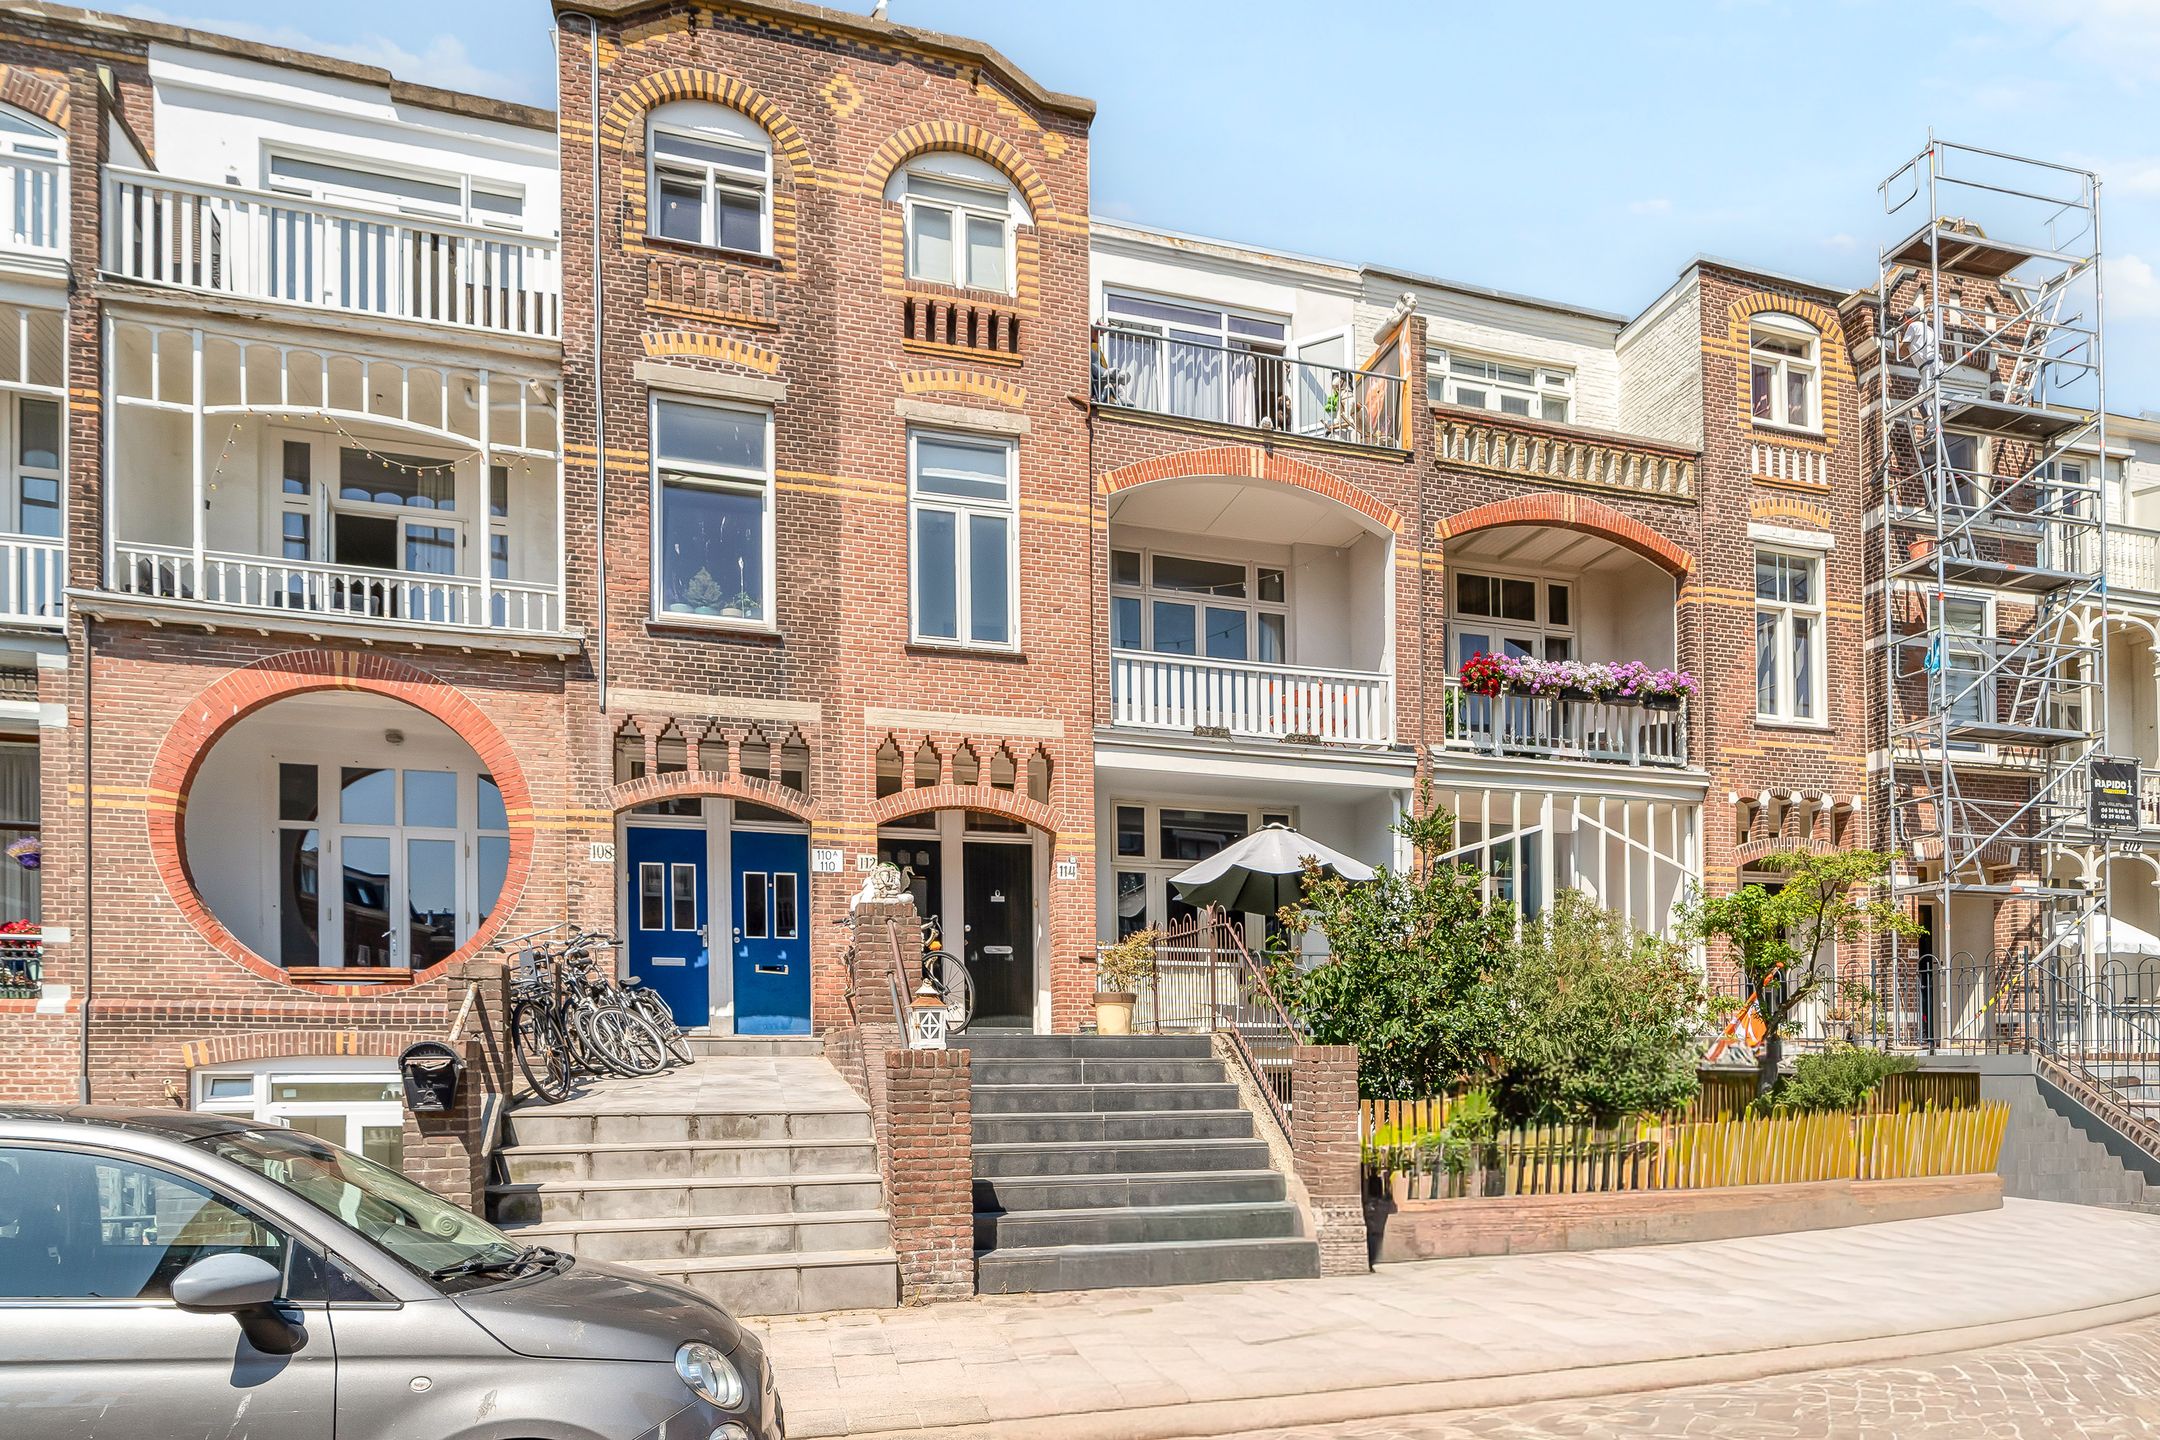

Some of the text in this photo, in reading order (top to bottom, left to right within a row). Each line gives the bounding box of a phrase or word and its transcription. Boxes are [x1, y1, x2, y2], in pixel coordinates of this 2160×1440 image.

[2094, 779, 2127, 789] RAPIDO
[592, 844, 613, 859] 108
[820, 861, 836, 871] 110
[1059, 865, 1076, 877] 114
